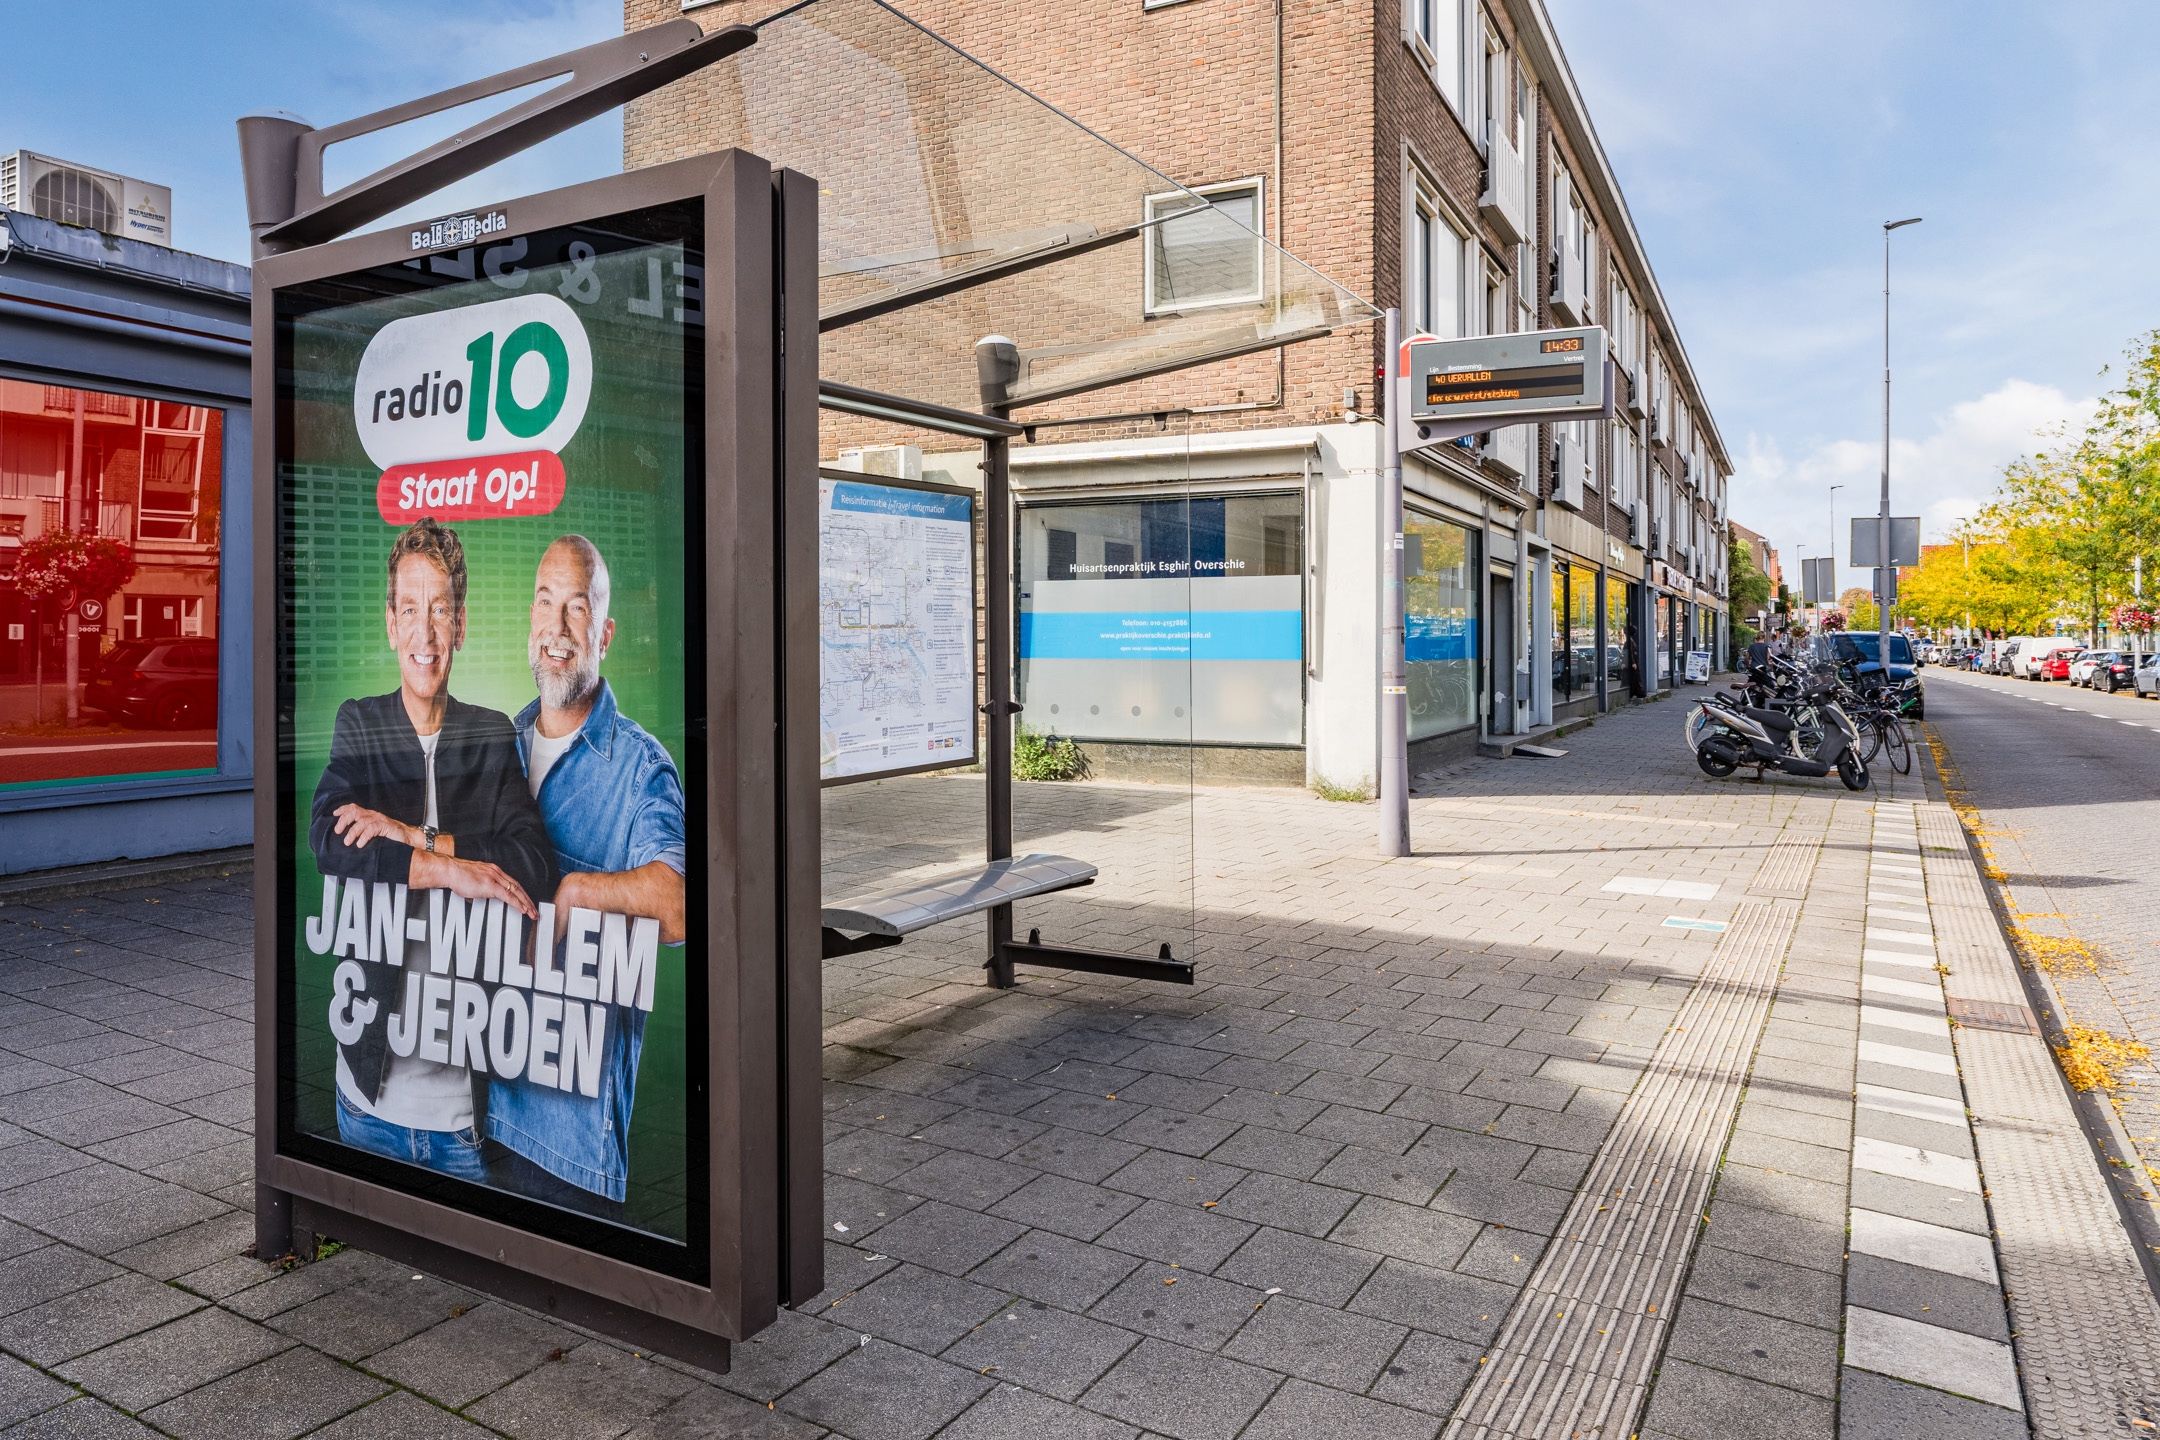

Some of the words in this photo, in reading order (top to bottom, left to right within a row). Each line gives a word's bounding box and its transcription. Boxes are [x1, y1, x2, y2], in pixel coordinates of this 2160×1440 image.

[130, 220, 148, 229] Hyper
[1545, 339, 1579, 353] 14:33
[1563, 354, 1585, 362] Vertrek
[372, 370, 464, 424] radio
[466, 320, 570, 443] 10
[1435, 375, 1446, 384] 40
[398, 468, 477, 511] Staat
[484, 460, 538, 511] Op!
[841, 494, 887, 508] Reisinformatie
[893, 500, 911, 511] Travel
[911, 503, 945, 514] information
[1069, 561, 1156, 574] Huisartsenpraktijk
[1194, 559, 1246, 571] Overschie
[305, 874, 660, 1012] JAN-WILLEM
[328, 959, 379, 1046] &
[386, 971, 607, 1099] JEROEN
